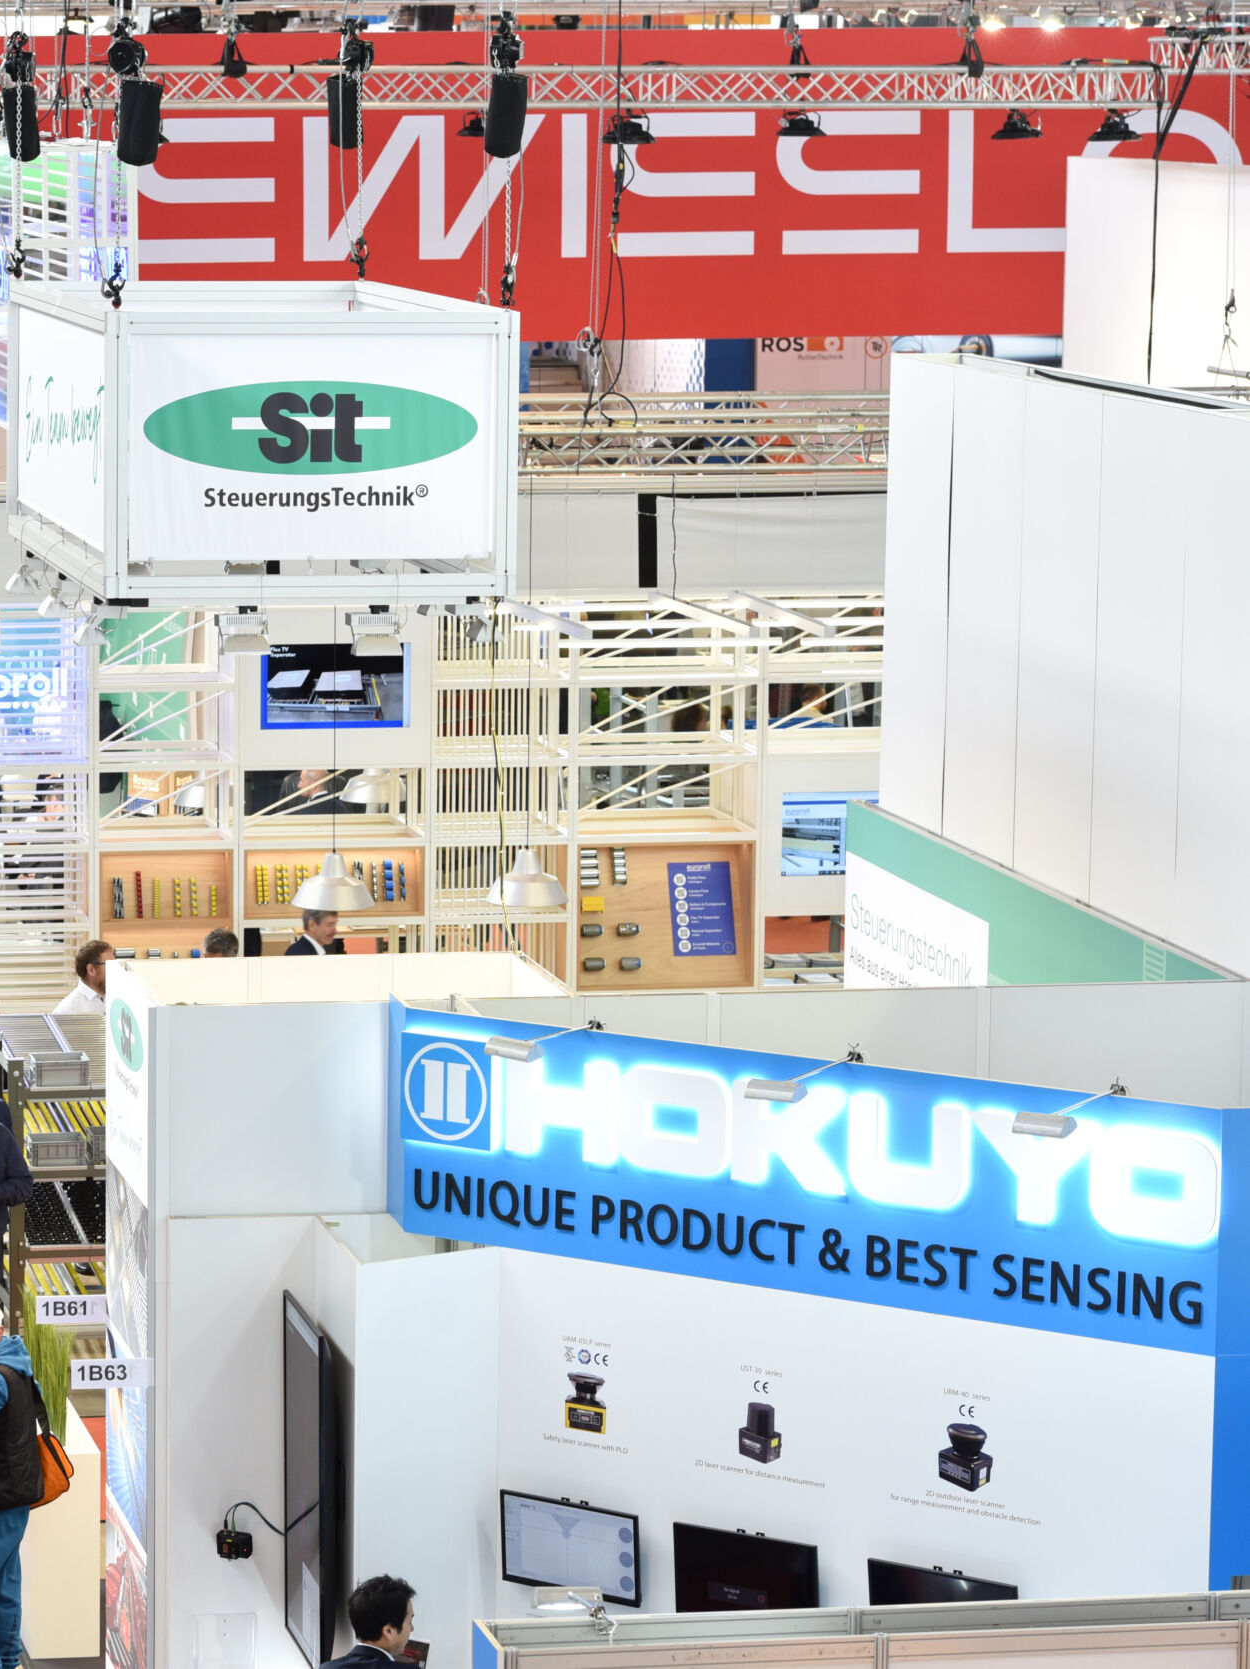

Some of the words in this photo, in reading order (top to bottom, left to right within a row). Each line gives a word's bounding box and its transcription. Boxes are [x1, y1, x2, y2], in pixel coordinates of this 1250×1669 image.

[850, 893, 972, 987] Steuerungstechnik
[504, 1057, 1220, 1247] HOKUYO
[413, 1167, 577, 1232] UNIQUE
[590, 1194, 805, 1266] PRODUCT
[817, 1228, 850, 1274] &
[865, 1233, 978, 1291] BEST
[991, 1253, 1203, 1326] SENSING
[41, 1300, 87, 1317] 1B61
[594, 1341, 612, 1349] series
[77, 1364, 128, 1381] 1B63
[764, 1368, 783, 1378] series
[943, 1387, 970, 1399] URM-40
[972, 1392, 991, 1402] series
[542, 1433, 561, 1444] Safety
[562, 1437, 576, 1446] laser
[577, 1440, 600, 1450] scanner
[601, 1443, 615, 1452] with
[694, 1459, 704, 1467] 2D
[704, 1460, 719, 1470] laser
[720, 1464, 744, 1475] scanner
[745, 1467, 755, 1476] for
[755, 1469, 782, 1481] distance
[782, 1475, 826, 1489] measurement
[925, 1489, 935, 1498] 2D
[935, 1491, 963, 1502] outdoor
[963, 1495, 979, 1505] laser
[979, 1498, 1006, 1510] scanner
[890, 1493, 900, 1502] for
[900, 1496, 920, 1506] range
[920, 1499, 966, 1514] measurement
[966, 1507, 980, 1516] and
[980, 1508, 1008, 1521] obstacle
[1008, 1513, 1041, 1527] detection
